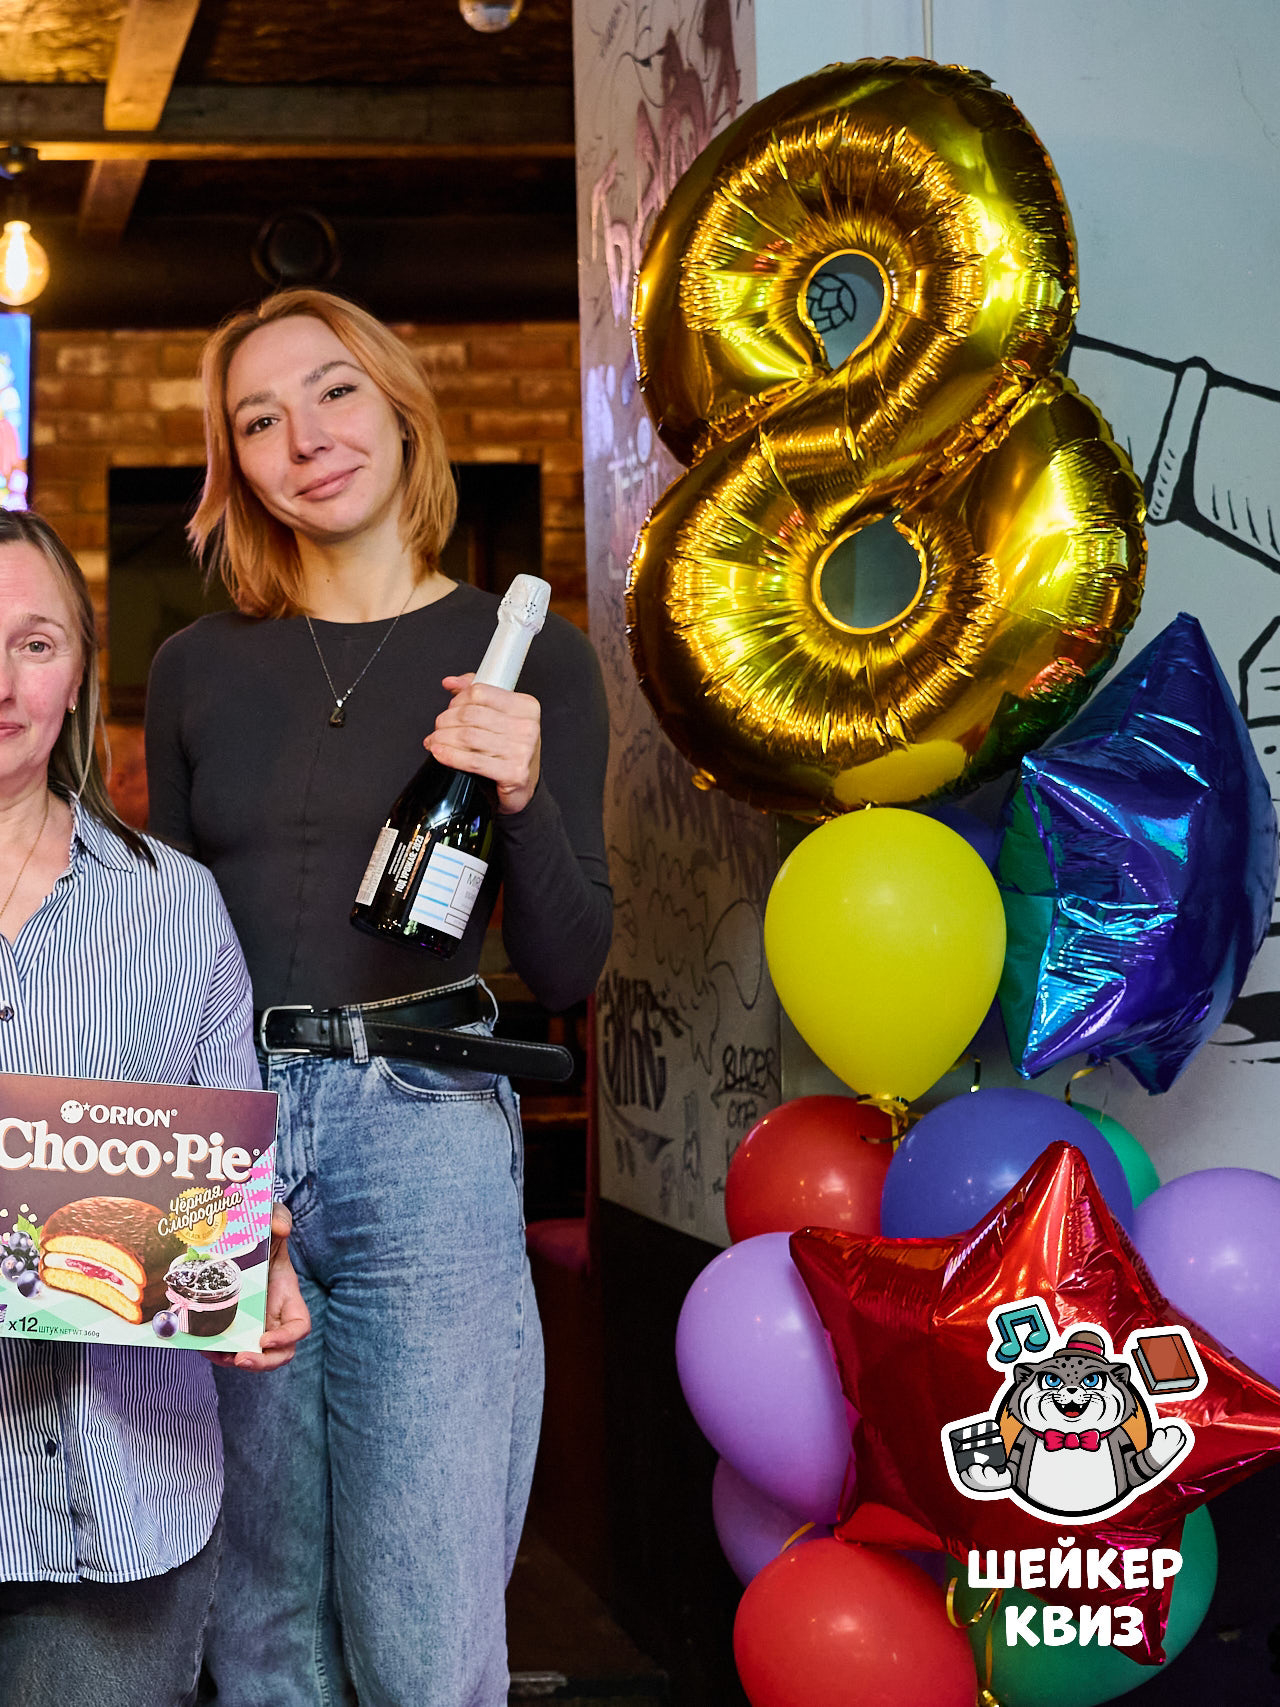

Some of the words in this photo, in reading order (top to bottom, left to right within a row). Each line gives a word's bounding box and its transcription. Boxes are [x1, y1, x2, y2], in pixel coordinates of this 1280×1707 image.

[89, 1104, 172, 1129] ORION
[158, 1190, 242, 1236] Смородина
[169, 1184, 223, 1215] Чёрная
